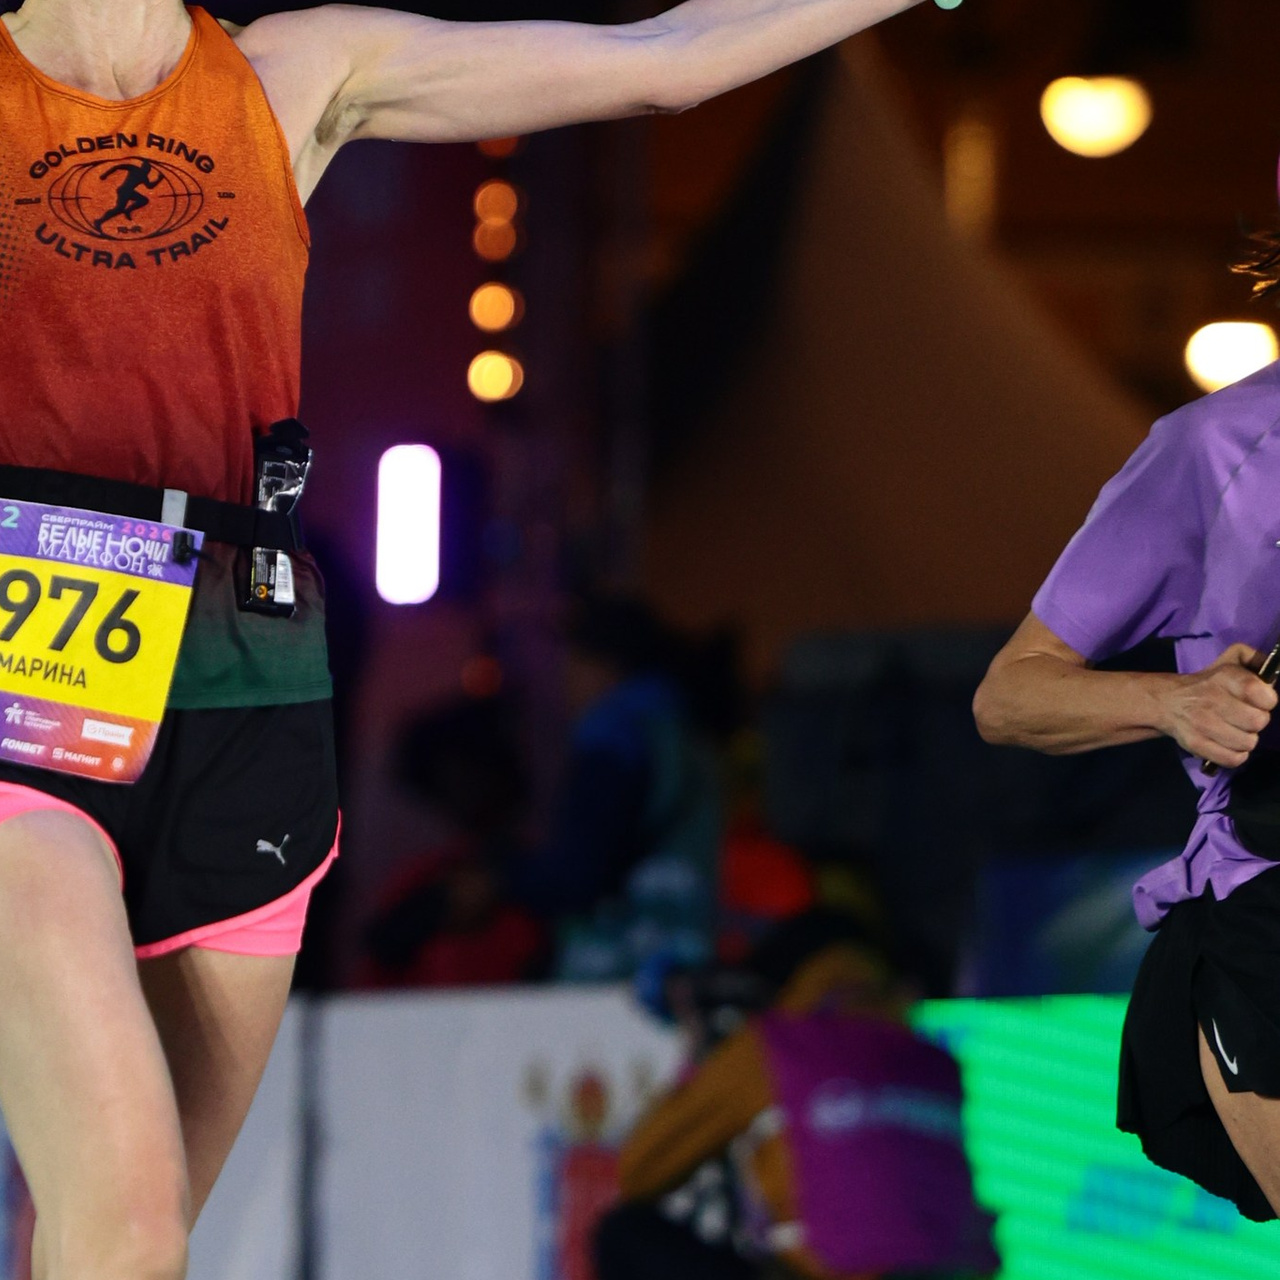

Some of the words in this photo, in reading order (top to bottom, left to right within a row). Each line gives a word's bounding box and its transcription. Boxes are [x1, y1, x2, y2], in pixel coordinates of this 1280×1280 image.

[29, 132, 138, 179] GOLDEN
[146, 133, 215, 174] RING
[35, 223, 136, 269] ULTRA
[146, 216, 229, 266] TRAIL
[37, 523, 104, 551] БЕЛЫЕ
[105, 533, 170, 563] НОЧИ
[41, 514, 114, 531] СБЕРПРАЙМ
[121, 521, 171, 541] 2026
[36, 540, 146, 574] МАРАФОН
[1, 738, 46, 756] FONBET
